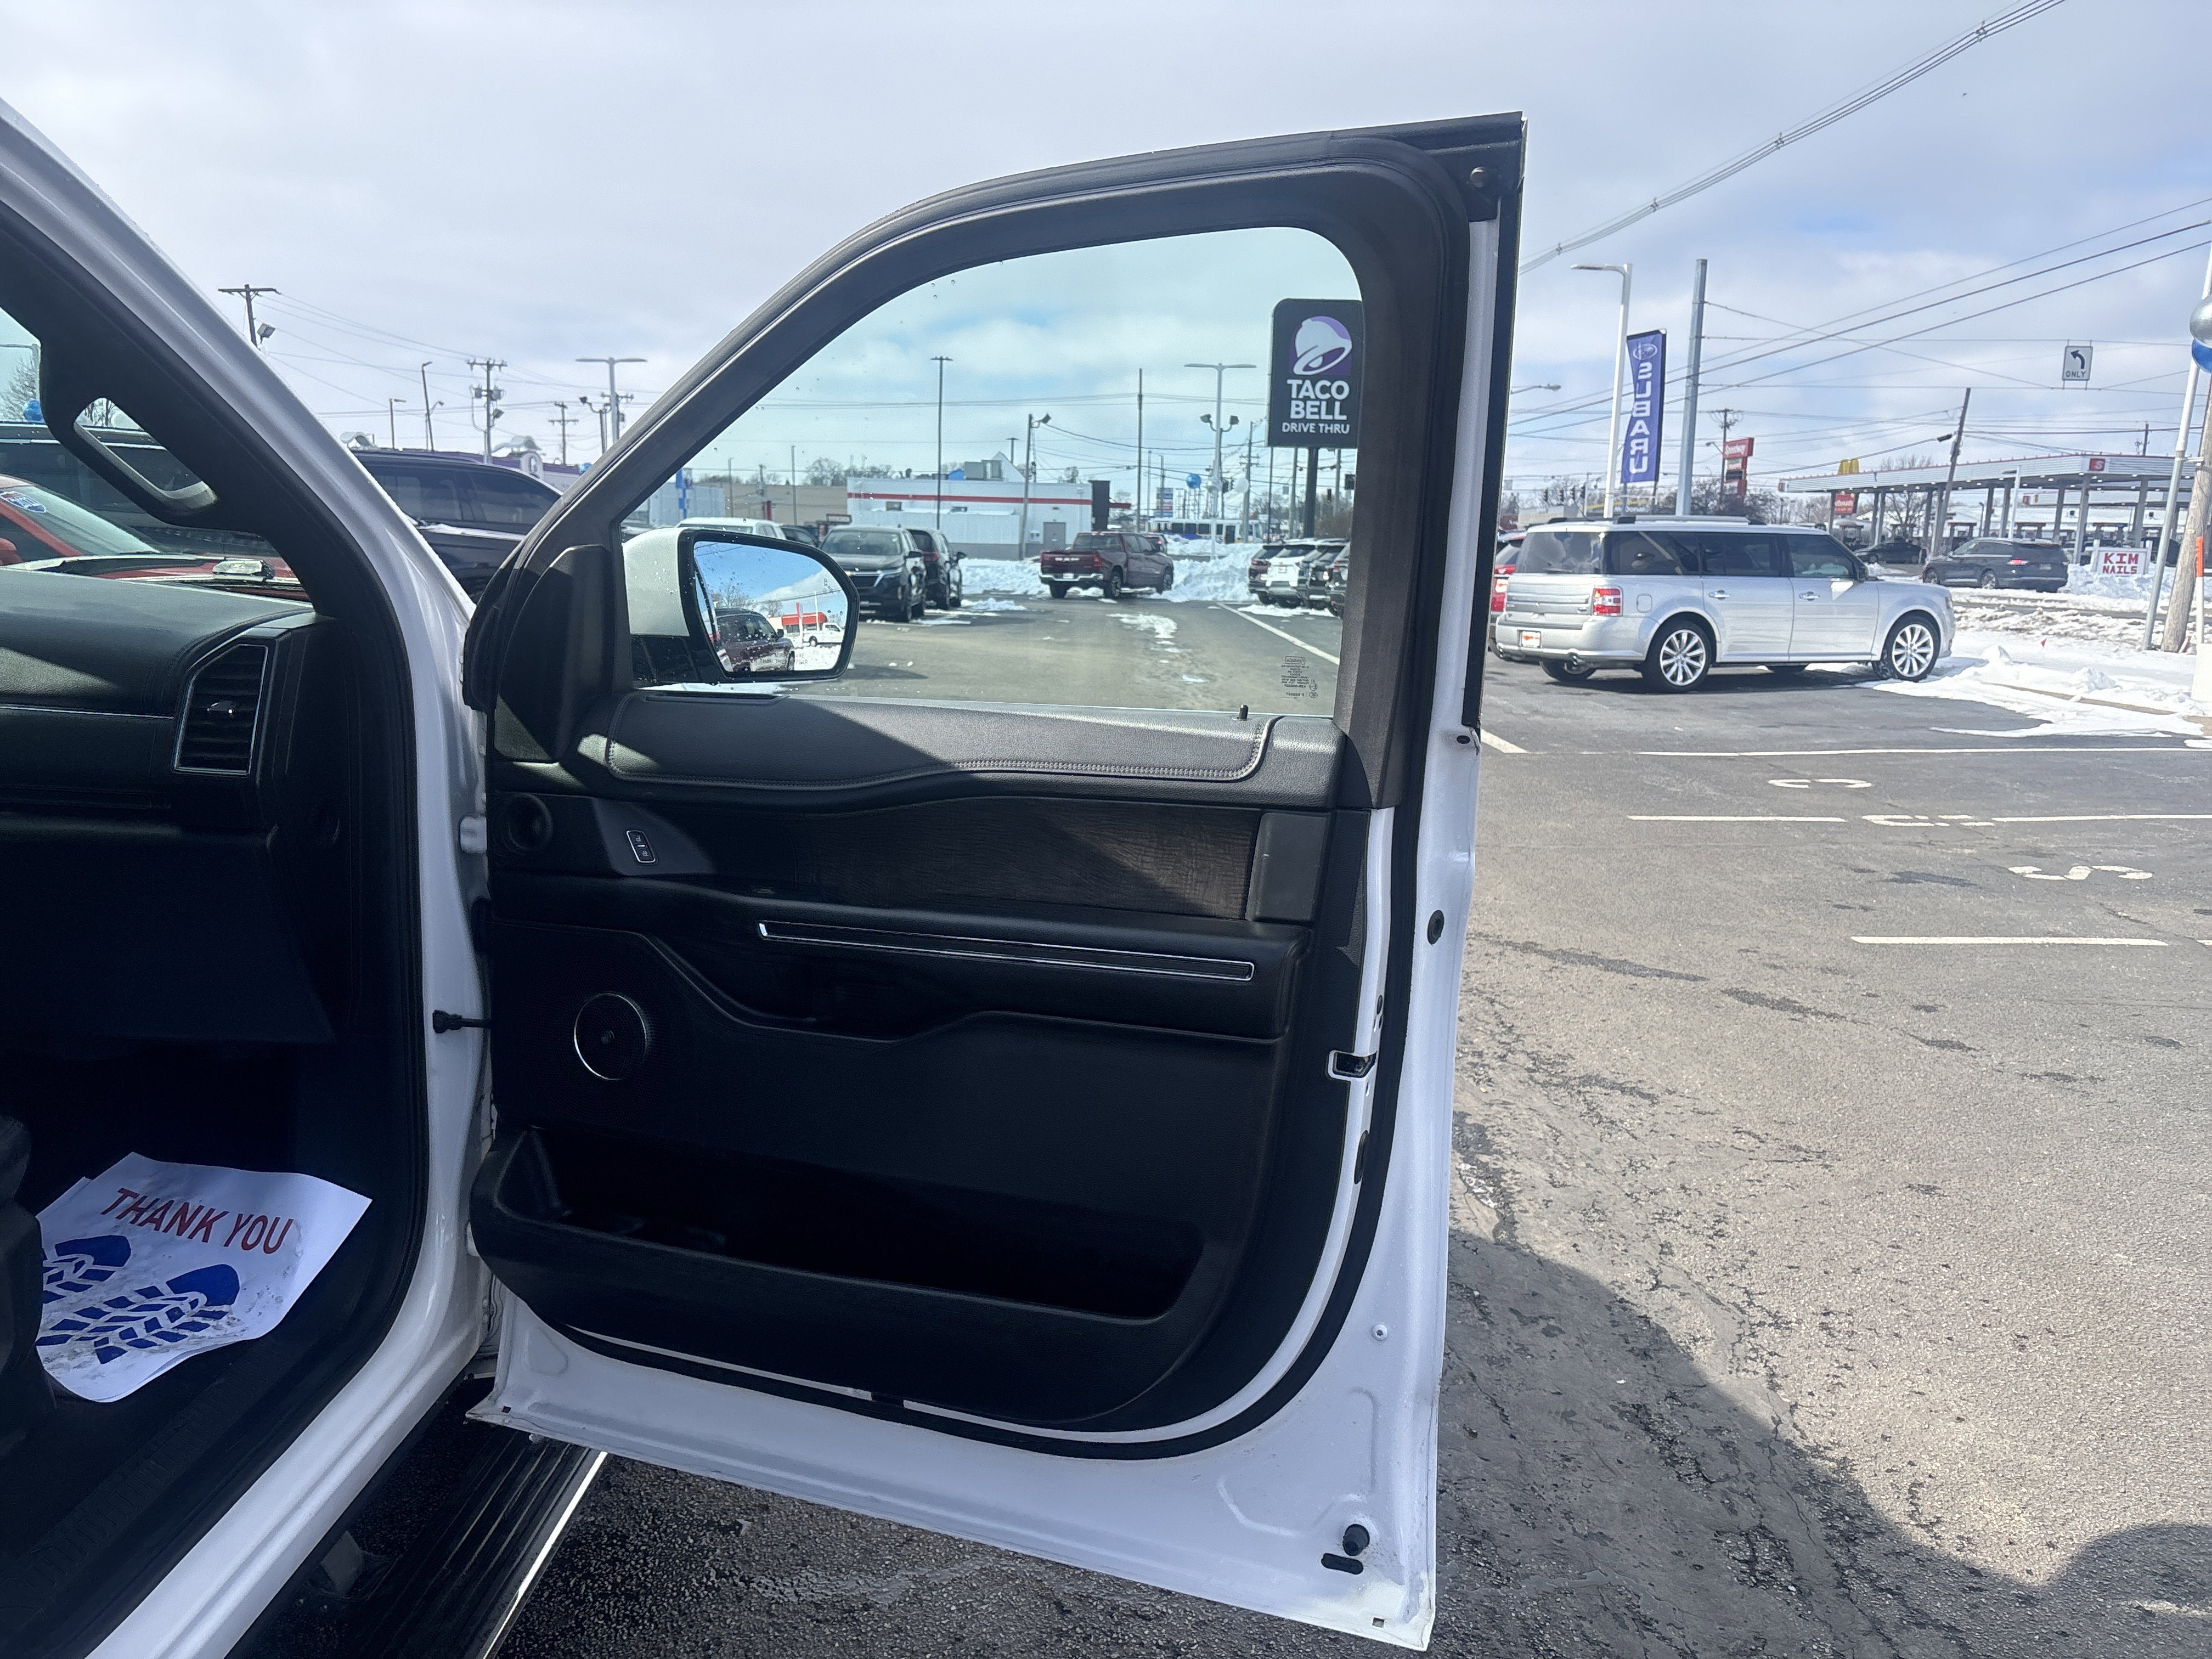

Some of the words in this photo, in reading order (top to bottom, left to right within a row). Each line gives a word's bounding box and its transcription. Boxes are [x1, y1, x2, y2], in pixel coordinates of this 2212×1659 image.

[2066, 370, 2086, 378] ONLY
[1286, 379, 1350, 400] TACO
[1290, 400, 1347, 421] BELL
[1282, 422, 1316, 433] DRIVE
[1318, 422, 1350, 434] THRU
[2103, 552, 2139, 564] KIM
[2102, 566, 2137, 574] NAILS
[101, 1187, 229, 1243] THANK
[223, 1213, 294, 1255] YOU
